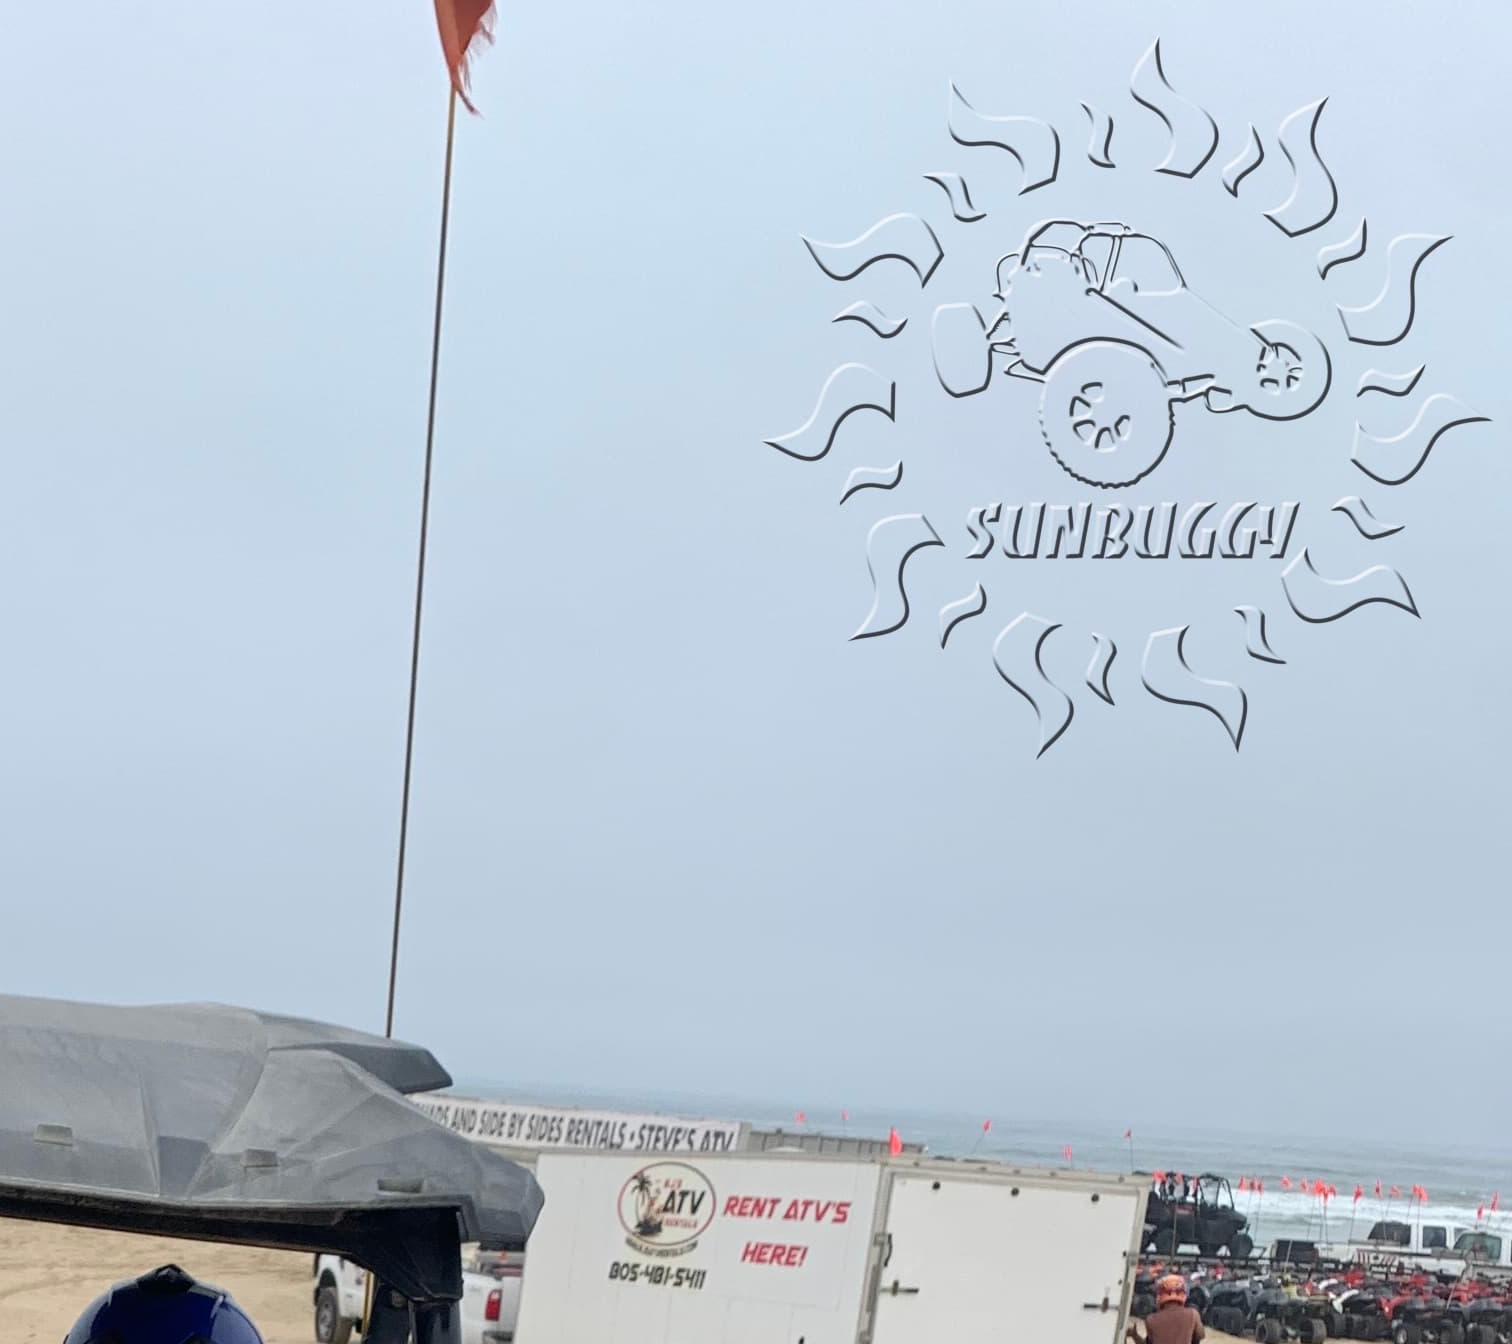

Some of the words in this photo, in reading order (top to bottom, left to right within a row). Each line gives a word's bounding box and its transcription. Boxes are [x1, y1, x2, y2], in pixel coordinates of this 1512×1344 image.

[451, 1106, 477, 1133] AND
[477, 1109, 505, 1138] SIDE
[506, 1112, 526, 1140] BY
[527, 1113, 564, 1144] SIDES
[567, 1117, 627, 1150] RENTALS
[635, 1123, 696, 1152] STEVE'S
[700, 1130, 735, 1152] ATV
[662, 1189, 706, 1215] ATV
[722, 1195, 782, 1220] RENT
[781, 1199, 852, 1224] ATV'S
[740, 1240, 809, 1268] HERE!
[608, 1261, 707, 1290] 805-481-5411
